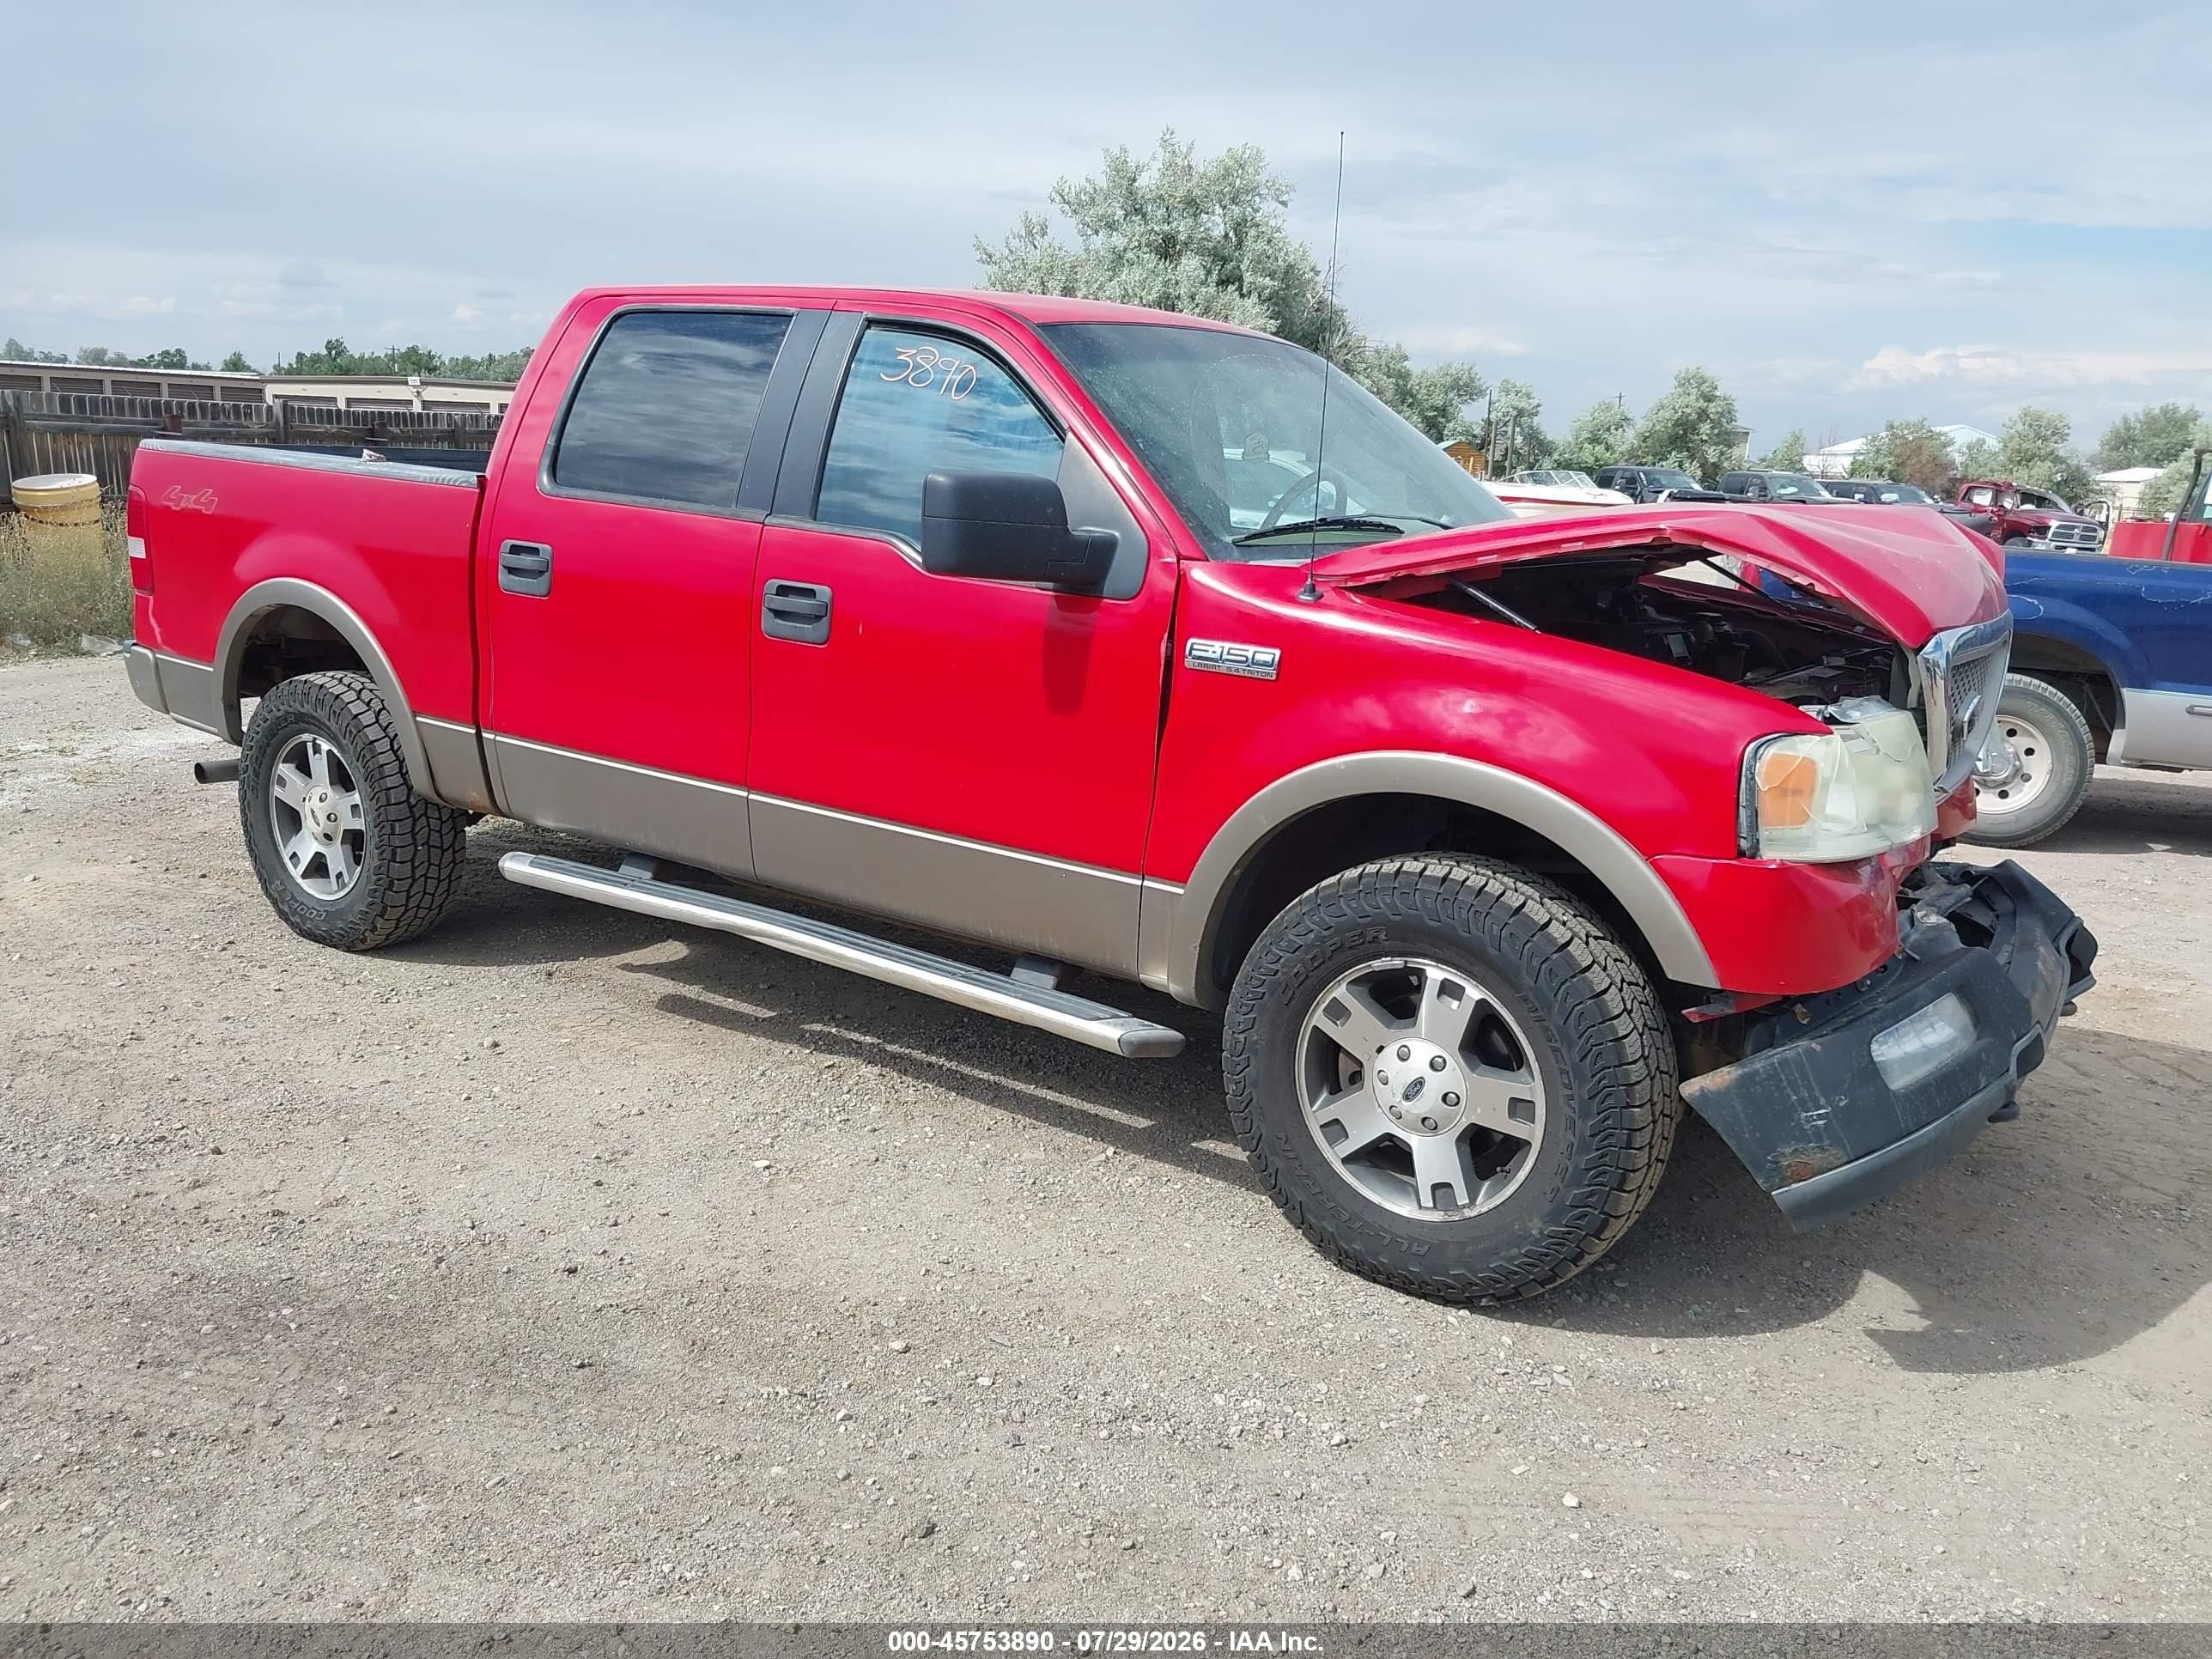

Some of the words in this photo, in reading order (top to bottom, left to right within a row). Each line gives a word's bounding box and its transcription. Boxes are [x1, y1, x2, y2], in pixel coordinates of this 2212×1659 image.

[880, 346, 976, 400] 3890
[161, 485, 218, 515] 4x4
[1187, 641, 1276, 669] F-150
[1192, 662, 1223, 671] LARIAT
[1243, 670, 1273, 679] TRITON
[1279, 927, 1389, 1006] COOPER
